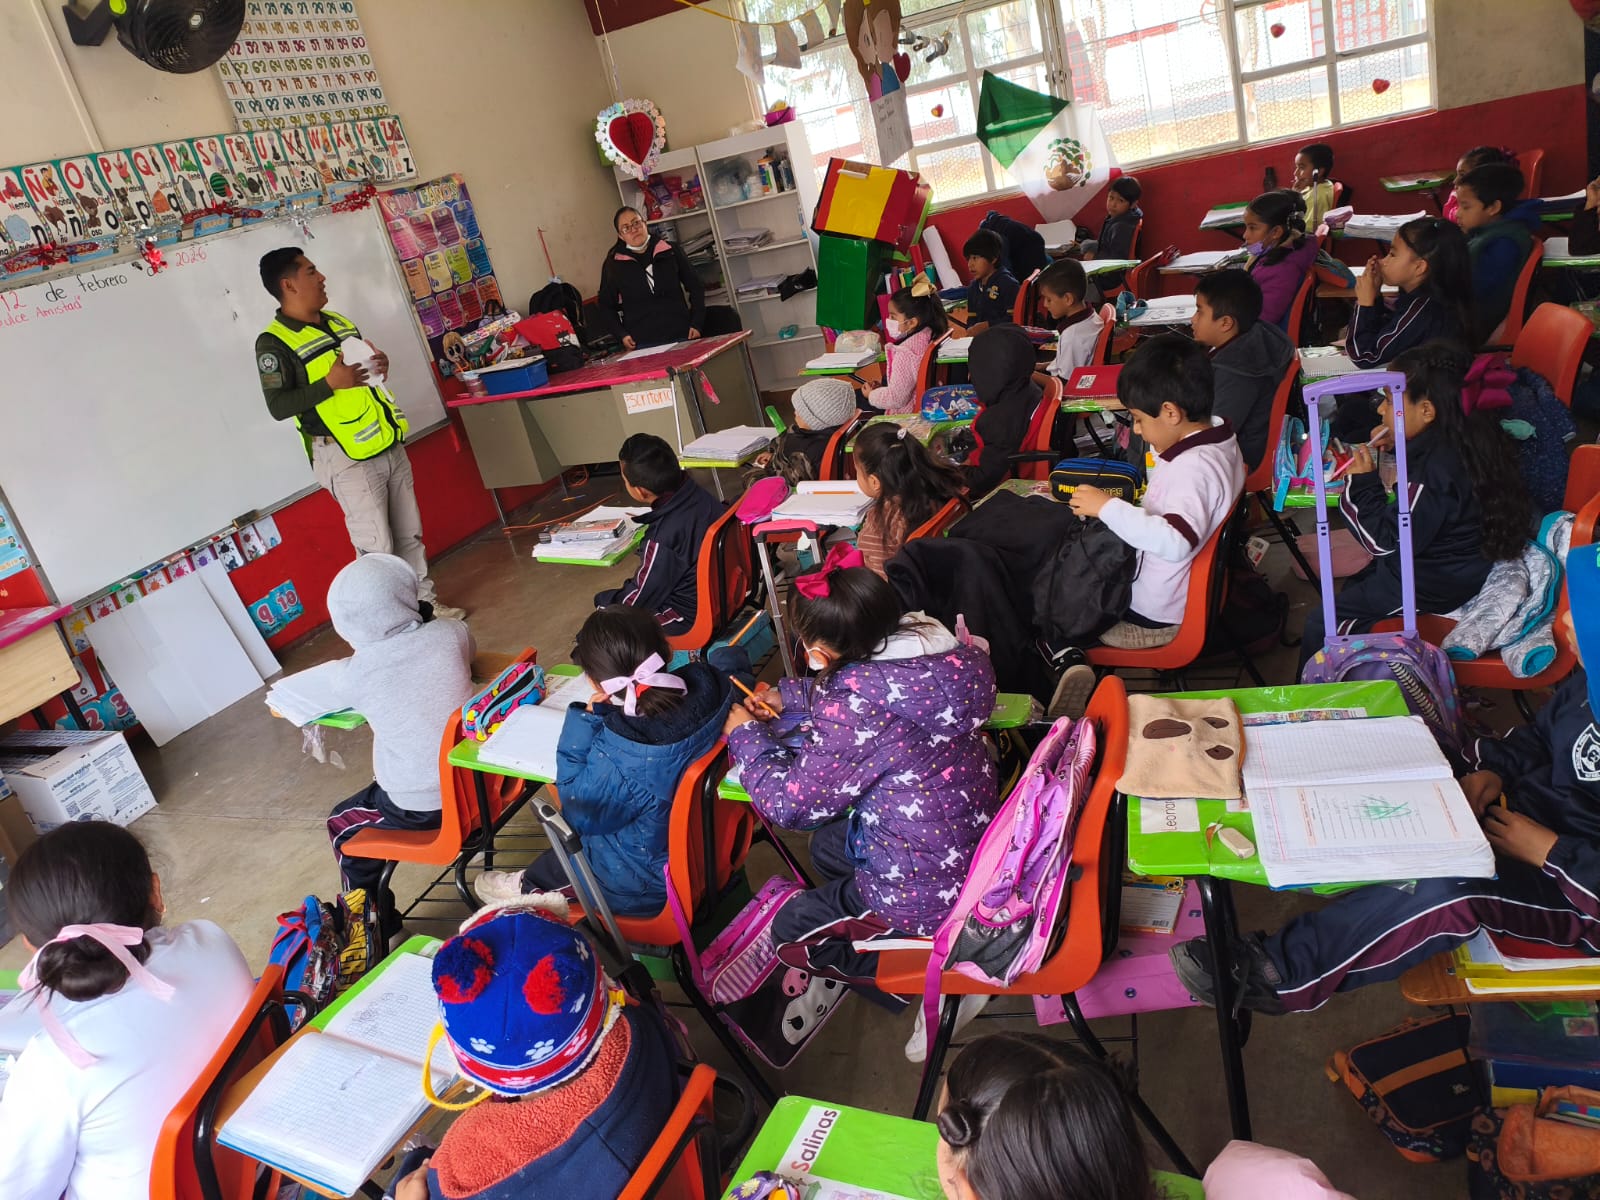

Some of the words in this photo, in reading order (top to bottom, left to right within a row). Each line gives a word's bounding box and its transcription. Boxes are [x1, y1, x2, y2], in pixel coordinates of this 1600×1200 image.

[24, 168, 49, 202] Ñ
[64, 162, 84, 190] O
[99, 157, 112, 183] P
[134, 152, 155, 176] Q
[165, 148, 181, 172] R
[196, 142, 211, 166] S
[225, 138, 238, 161] T
[254, 136, 268, 160] U
[282, 132, 294, 155] V
[307, 128, 320, 150] W
[333, 126, 346, 148] X
[355, 123, 366, 145] Y
[91, 228, 103, 237] oso
[45, 281, 68, 302] de
[76, 273, 128, 293] febrero
[175, 246, 208, 267] 2026
[276, 590, 297, 611] 10
[110, 692, 129, 717] 3
[84, 708, 104, 730] 2
[791, 1109, 838, 1172] Salinas
